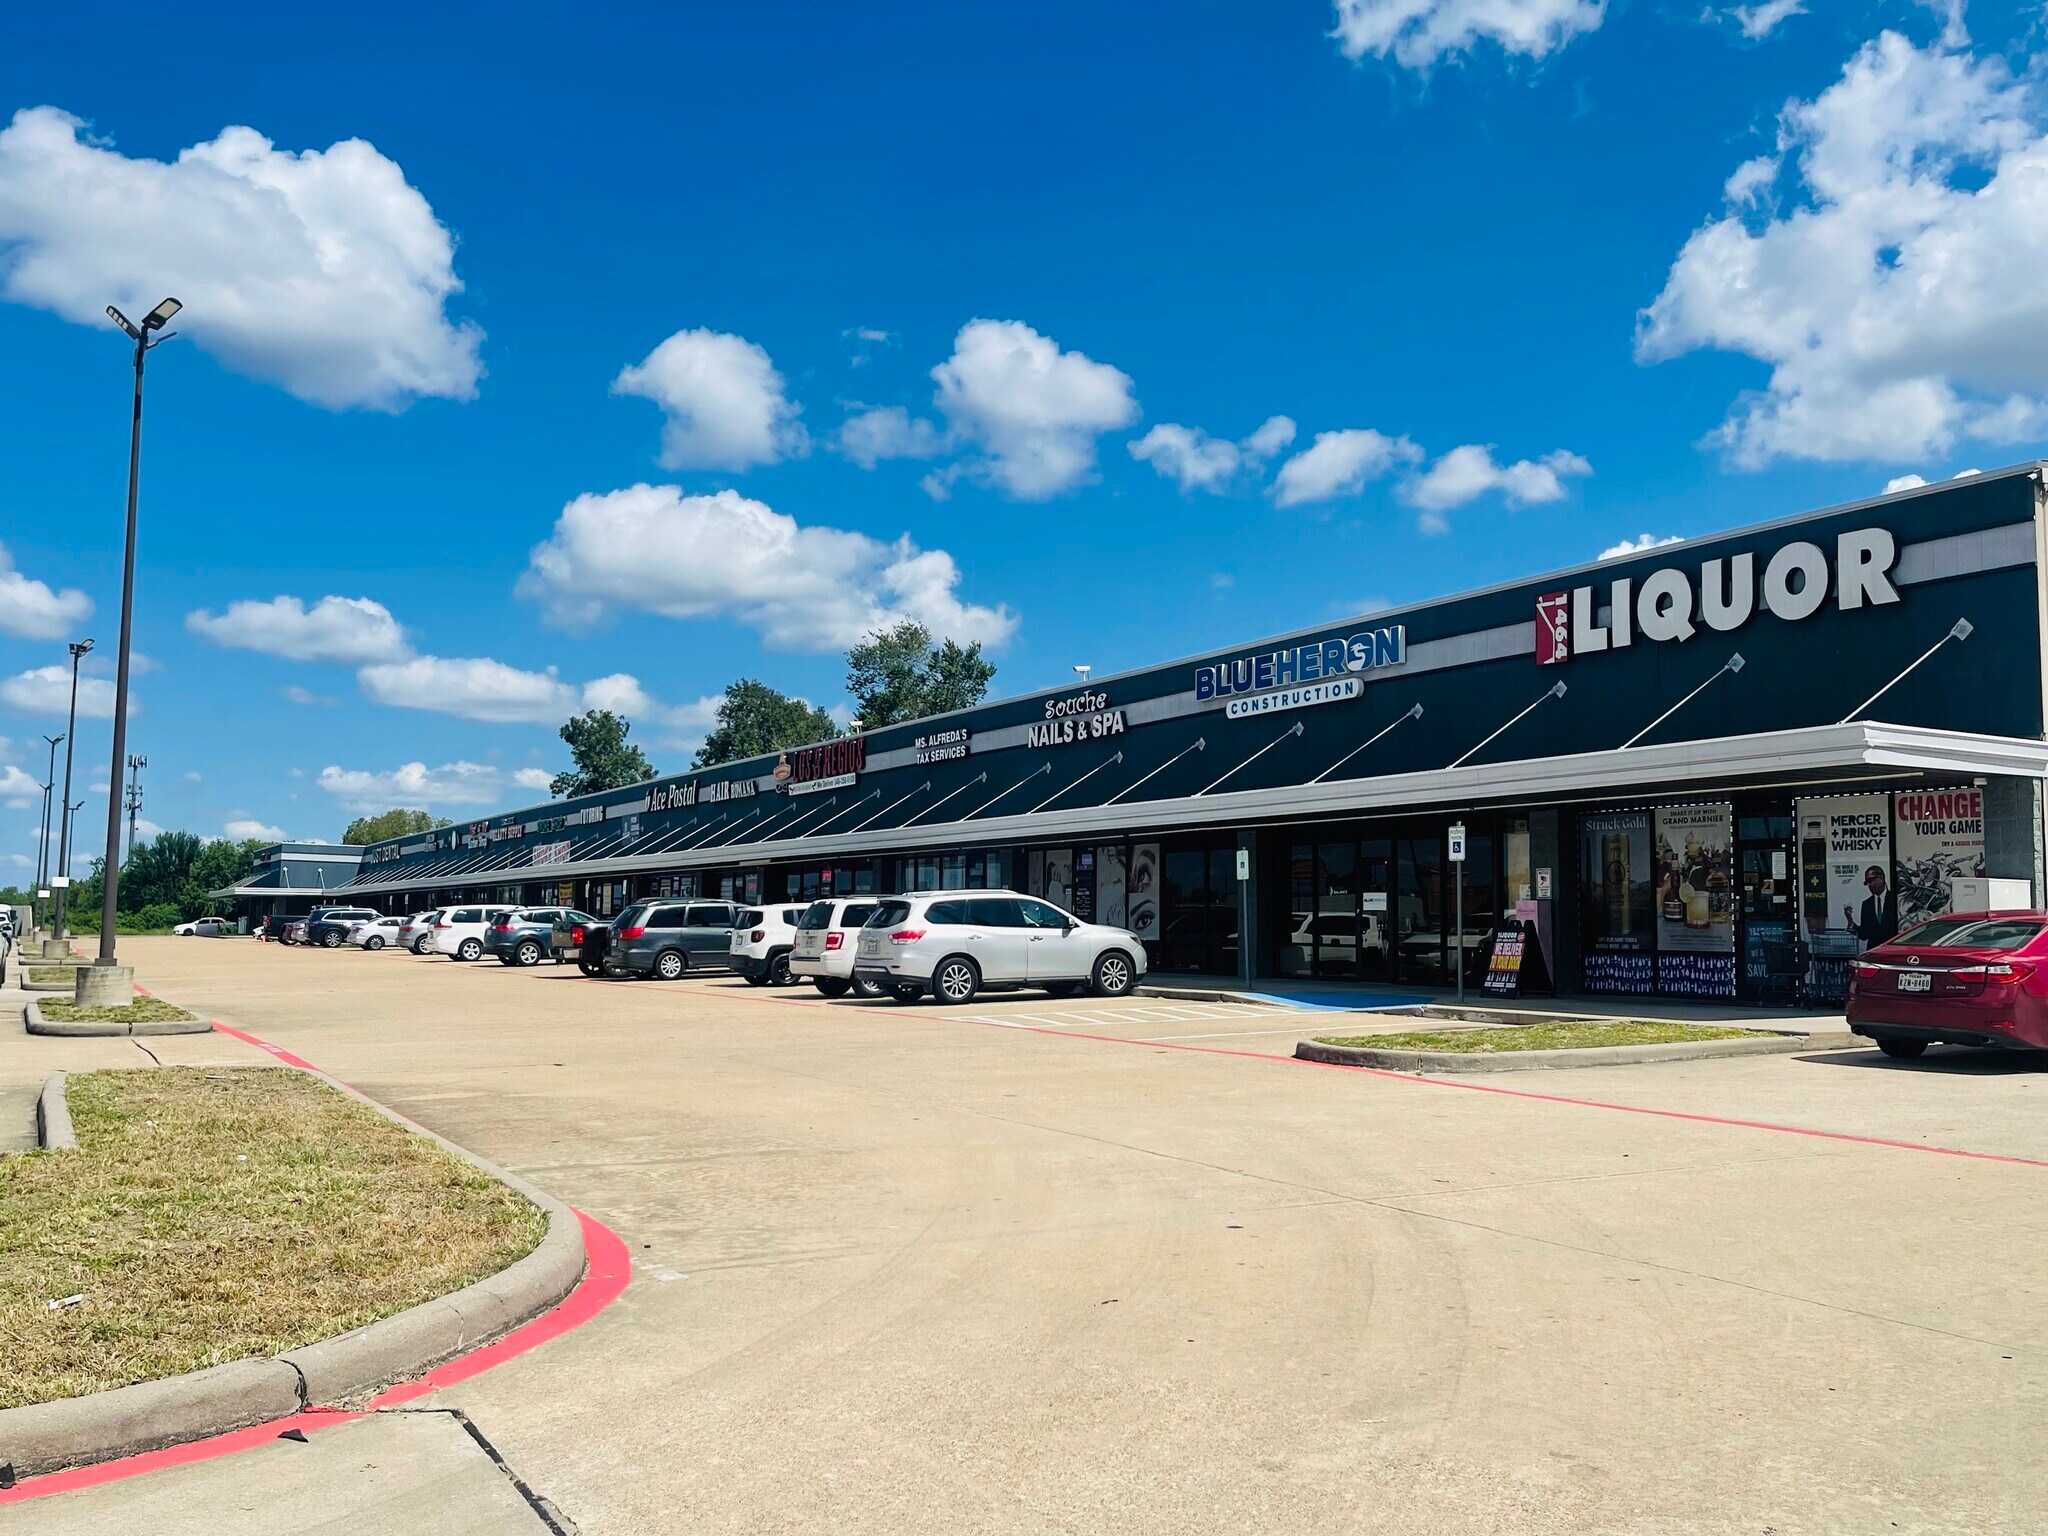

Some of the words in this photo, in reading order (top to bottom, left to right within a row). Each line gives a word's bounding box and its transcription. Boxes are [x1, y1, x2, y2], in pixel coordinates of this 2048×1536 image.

[1573, 527, 1900, 654] LIQUOR
[1555, 593, 1568, 659] 1464
[1195, 625, 1406, 702] BLUEHERON
[1045, 690, 1107, 719] Souche
[1230, 681, 1354, 715] CONSTRUCTION
[915, 737, 928, 749] MS.
[929, 727, 968, 747] ALFREDA'S
[1028, 720, 1074, 748] NAILS
[1078, 722, 1087, 739] &
[1092, 711, 1124, 739] SPA
[793, 749, 813, 783] LOS
[823, 736, 865, 776] REGIOS
[916, 753, 930, 765] TAX
[931, 745, 966, 762] SERVICES
[650, 786, 666, 812] Ace
[667, 779, 699, 809] Postal
[710, 780, 730, 803] HAIR
[1662, 817, 1689, 825] GRAND
[1690, 814, 1724, 823] MARNIER
[1898, 791, 1981, 822] CHANGE
[1585, 817, 1621, 832] Struck
[1622, 816, 1646, 830] Gold
[1831, 814, 1881, 827] MERCER
[1831, 830, 1839, 838] +
[1841, 826, 1888, 838] PRINCE
[1915, 821, 1946, 836] YOUR
[1949, 819, 1982, 834] GAME
[1831, 838, 1884, 852] WHISKY
